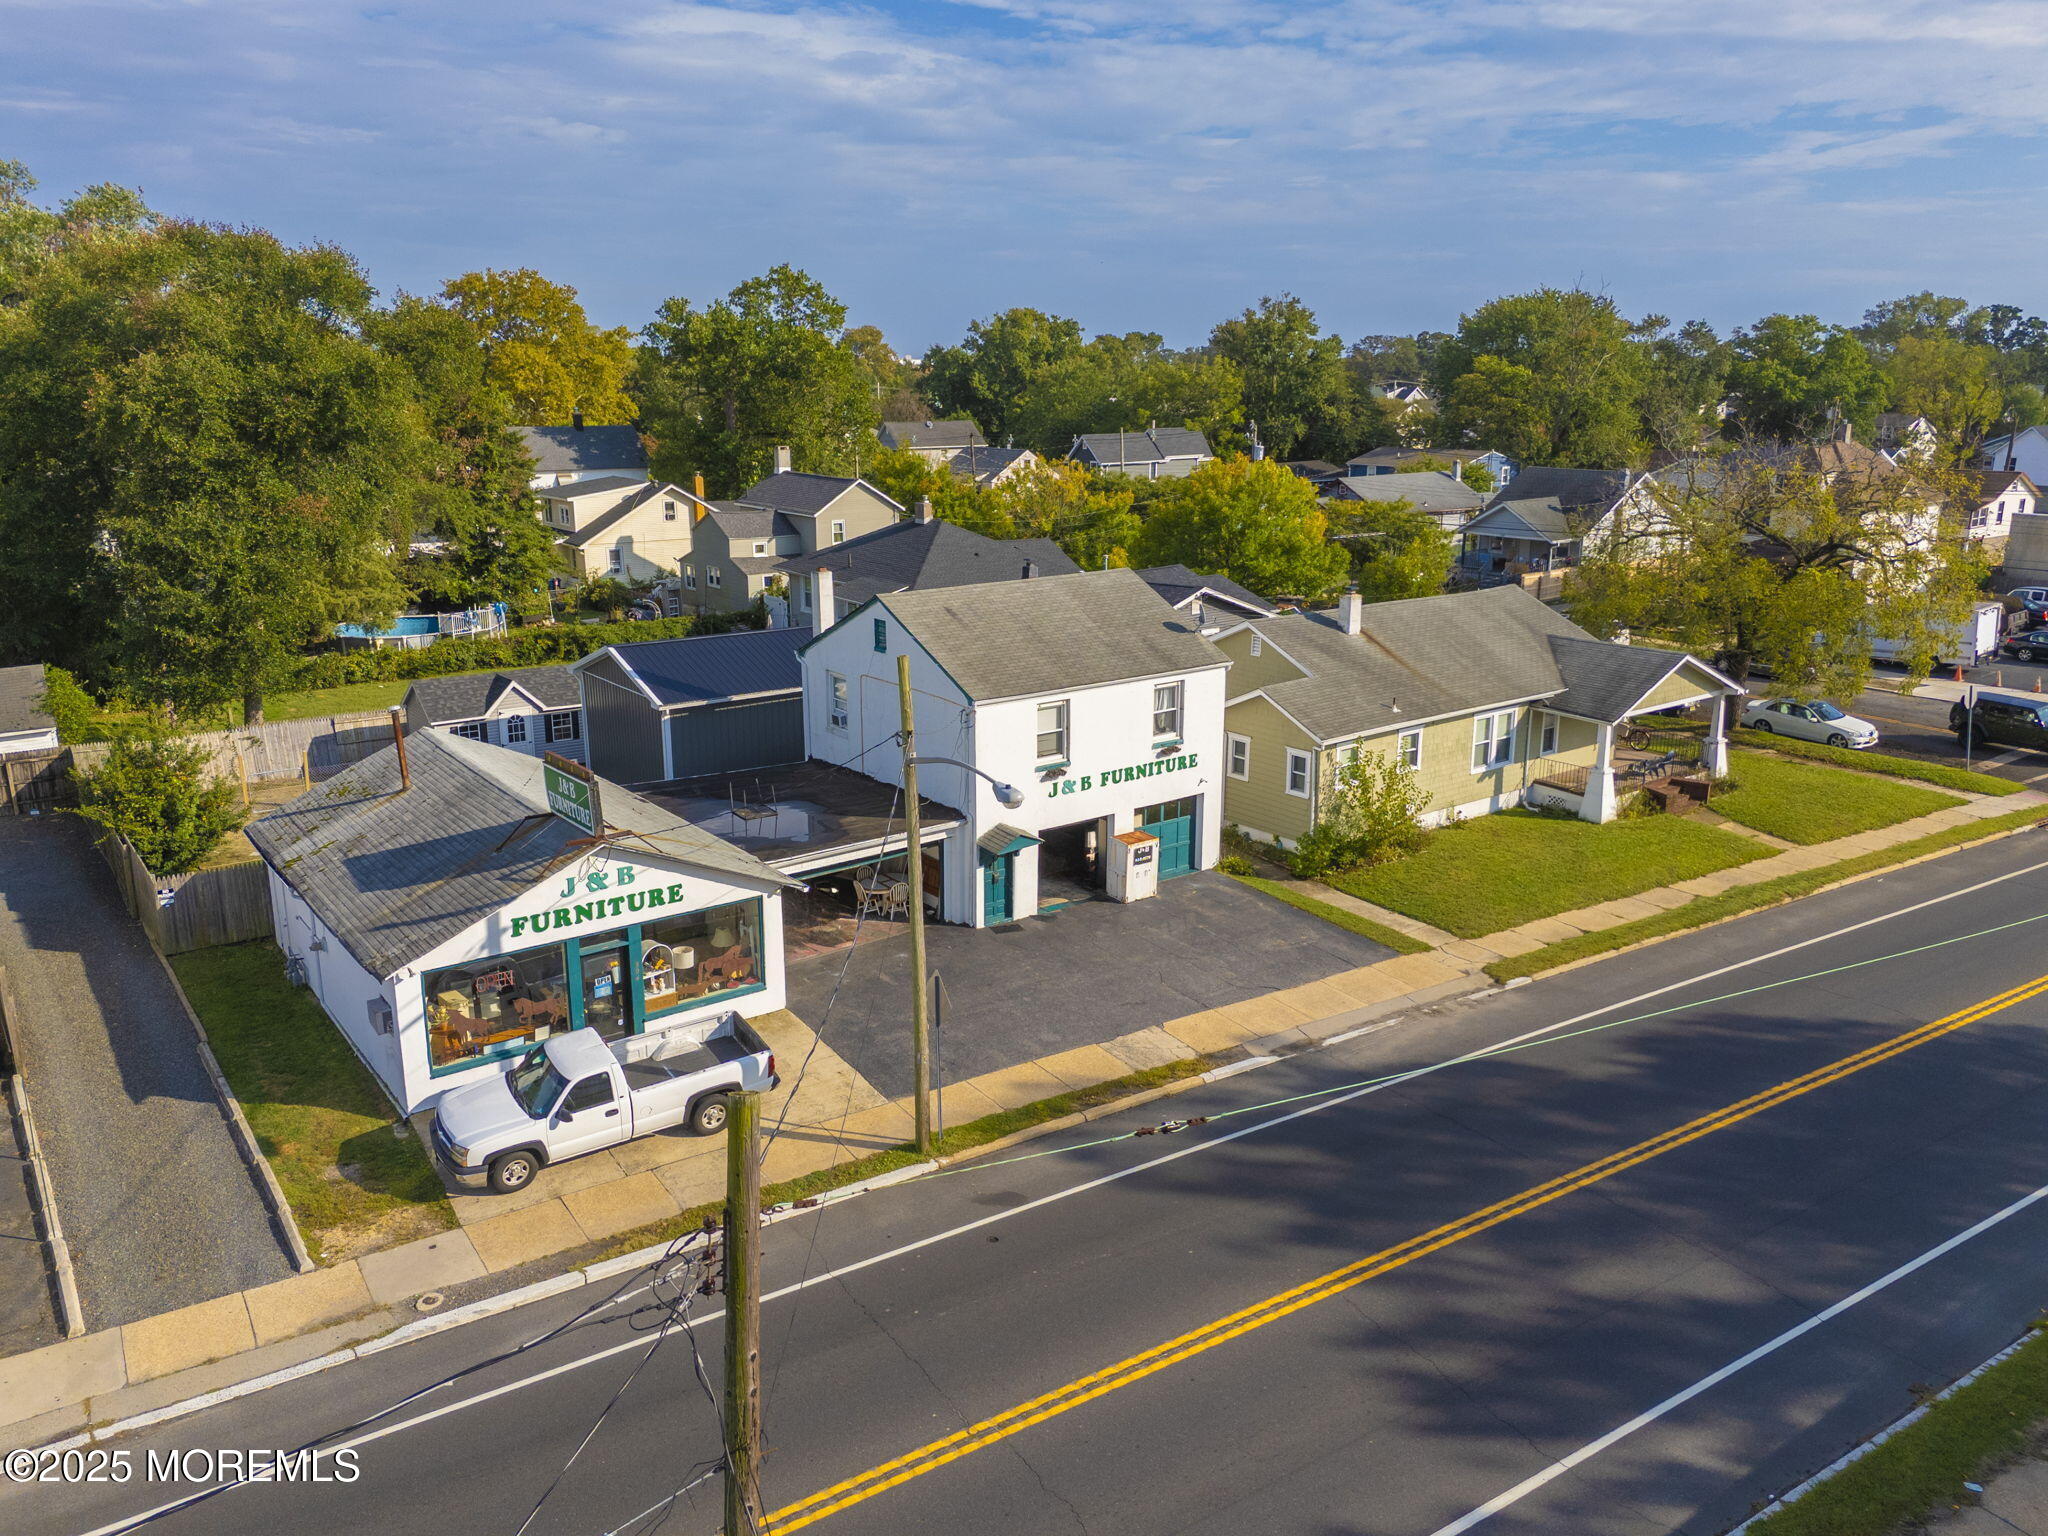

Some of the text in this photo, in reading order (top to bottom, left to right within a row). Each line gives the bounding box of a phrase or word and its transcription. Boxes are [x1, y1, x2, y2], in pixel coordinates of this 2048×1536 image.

[1100, 753, 1198, 787] FURNITURE
[558, 777, 576, 799] J&B
[549, 790, 592, 827] FURNITURE
[510, 883, 684, 938] FURNITURE
[475, 969, 515, 993] OPEN
